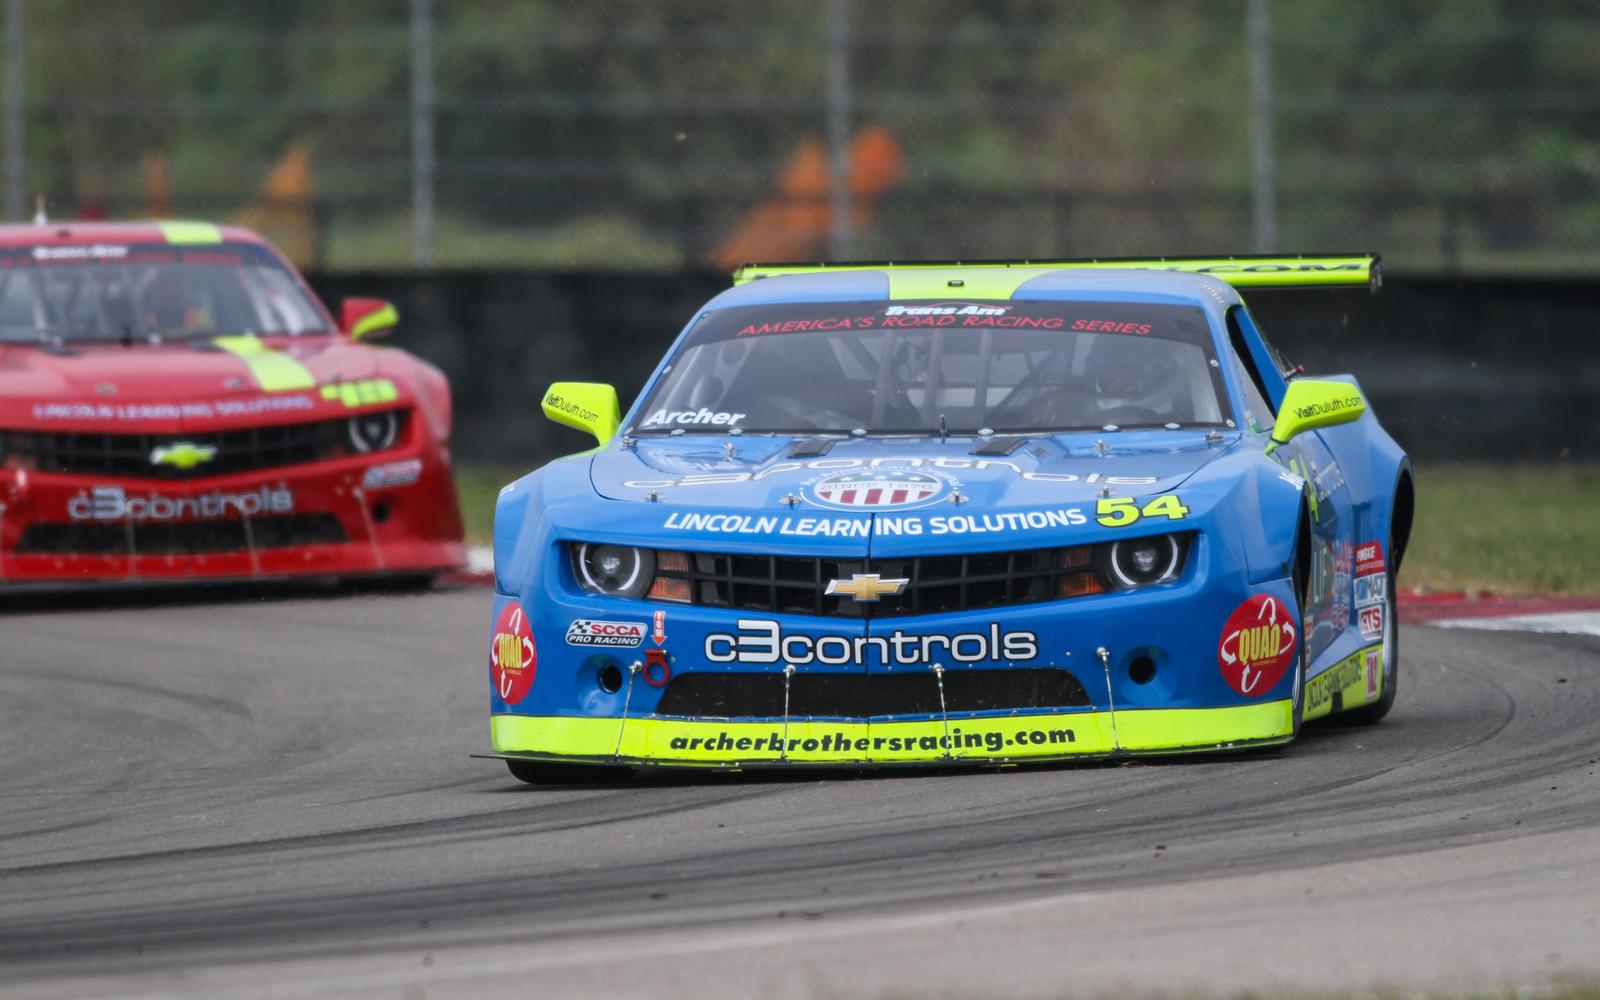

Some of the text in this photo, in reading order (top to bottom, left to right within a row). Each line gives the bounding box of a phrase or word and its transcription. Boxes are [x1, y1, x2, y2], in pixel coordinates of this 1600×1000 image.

[884, 305, 1007, 317] Trans Am
[736, 314, 1152, 337] AMERICA'S ROAD RACING SERIES
[643, 408, 746, 426] Archer
[68, 486, 293, 521] c3controls
[1094, 494, 1191, 528] 54
[663, 508, 1088, 537] LINCOLN LEARNING SOLUTIONS
[568, 635, 640, 646] PRO RACING
[590, 623, 642, 637] SCCA
[704, 619, 1038, 665] c3controls
[498, 632, 523, 670] QUAD
[1238, 623, 1281, 667] QUAD
[669, 727, 1076, 753] archerbrothersracing.com
